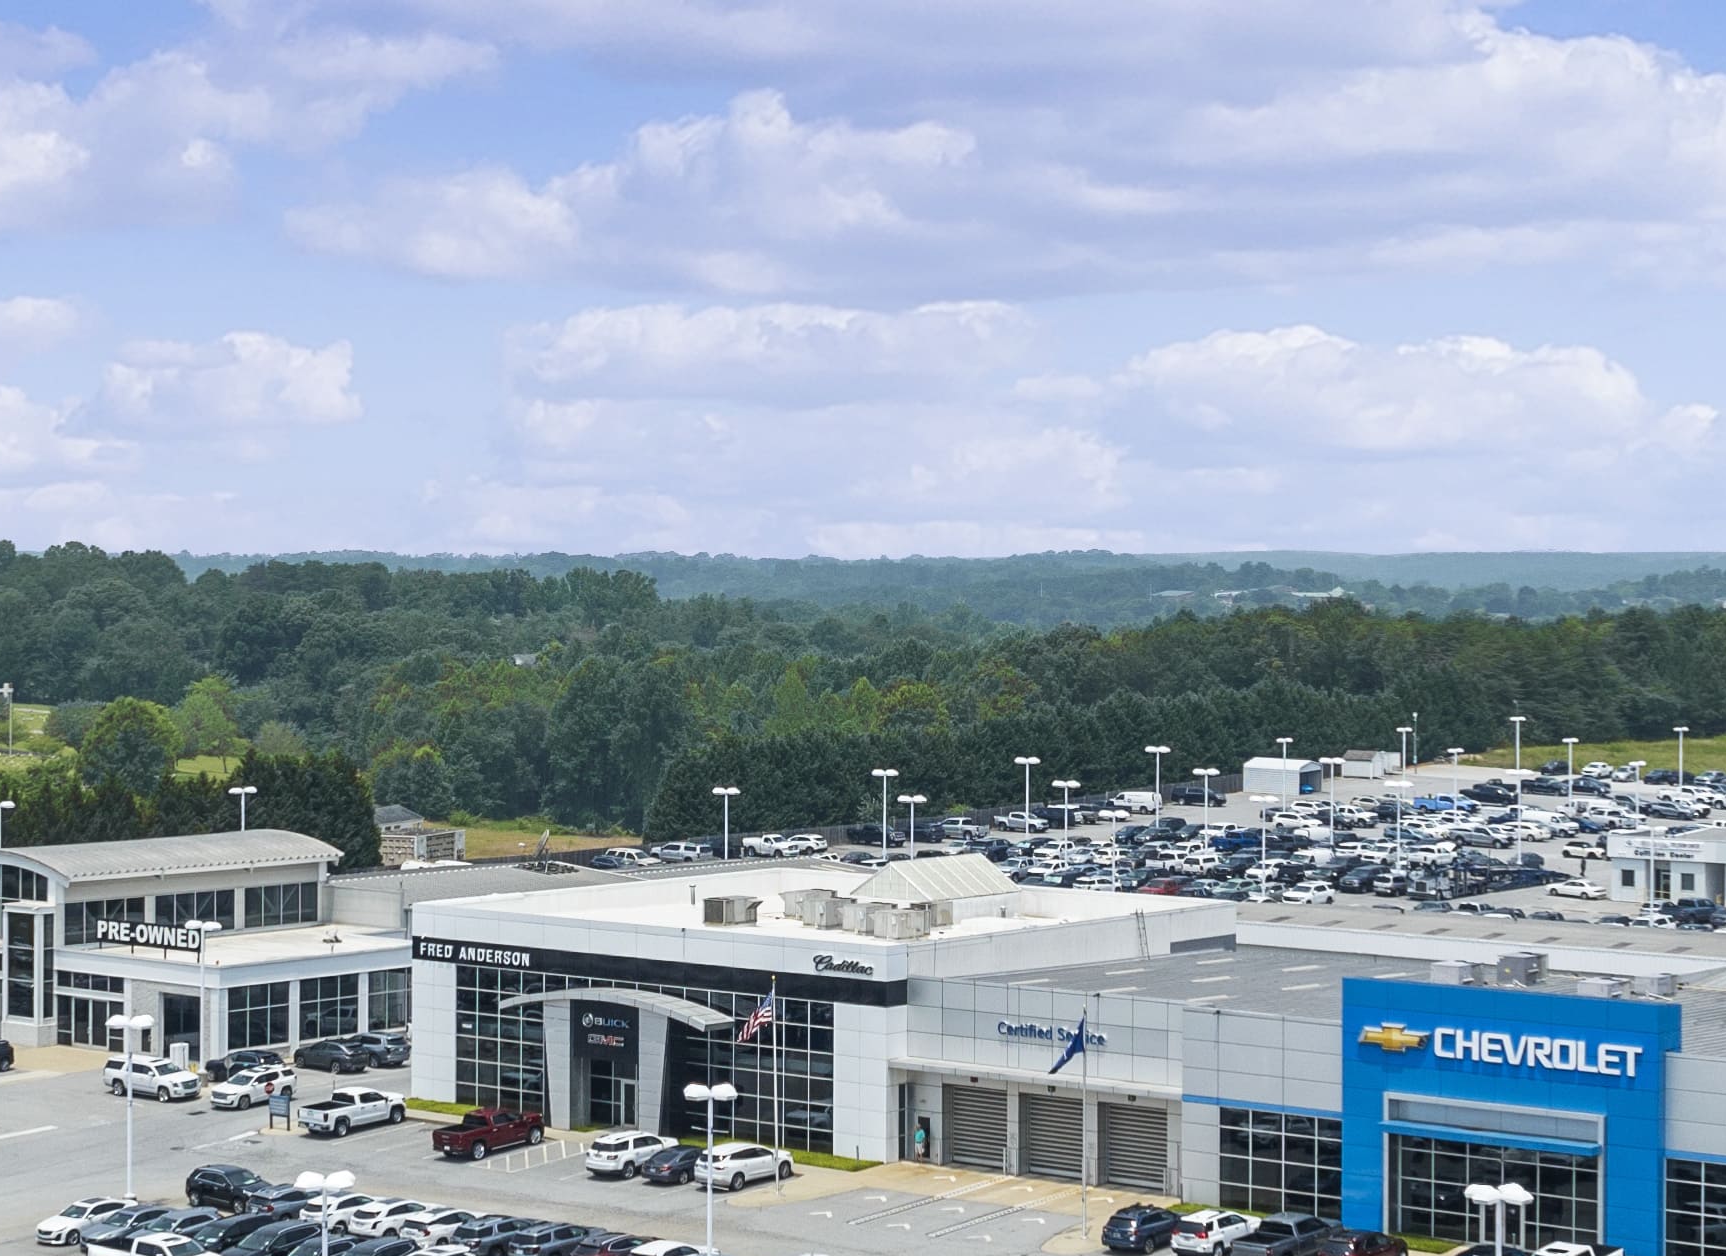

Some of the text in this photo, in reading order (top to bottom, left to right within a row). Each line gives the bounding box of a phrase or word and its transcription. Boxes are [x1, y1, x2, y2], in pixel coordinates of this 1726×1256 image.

[97, 920, 201, 949] PRE-OWNED
[420, 942, 530, 967] FRED ANDERSON
[813, 954, 874, 976] Cadillac
[594, 1017, 630, 1029] BUICK
[997, 1021, 1106, 1046] Certified Seice
[587, 1033, 625, 1047] GMC
[1434, 1027, 1643, 1077] CHEVROLET
